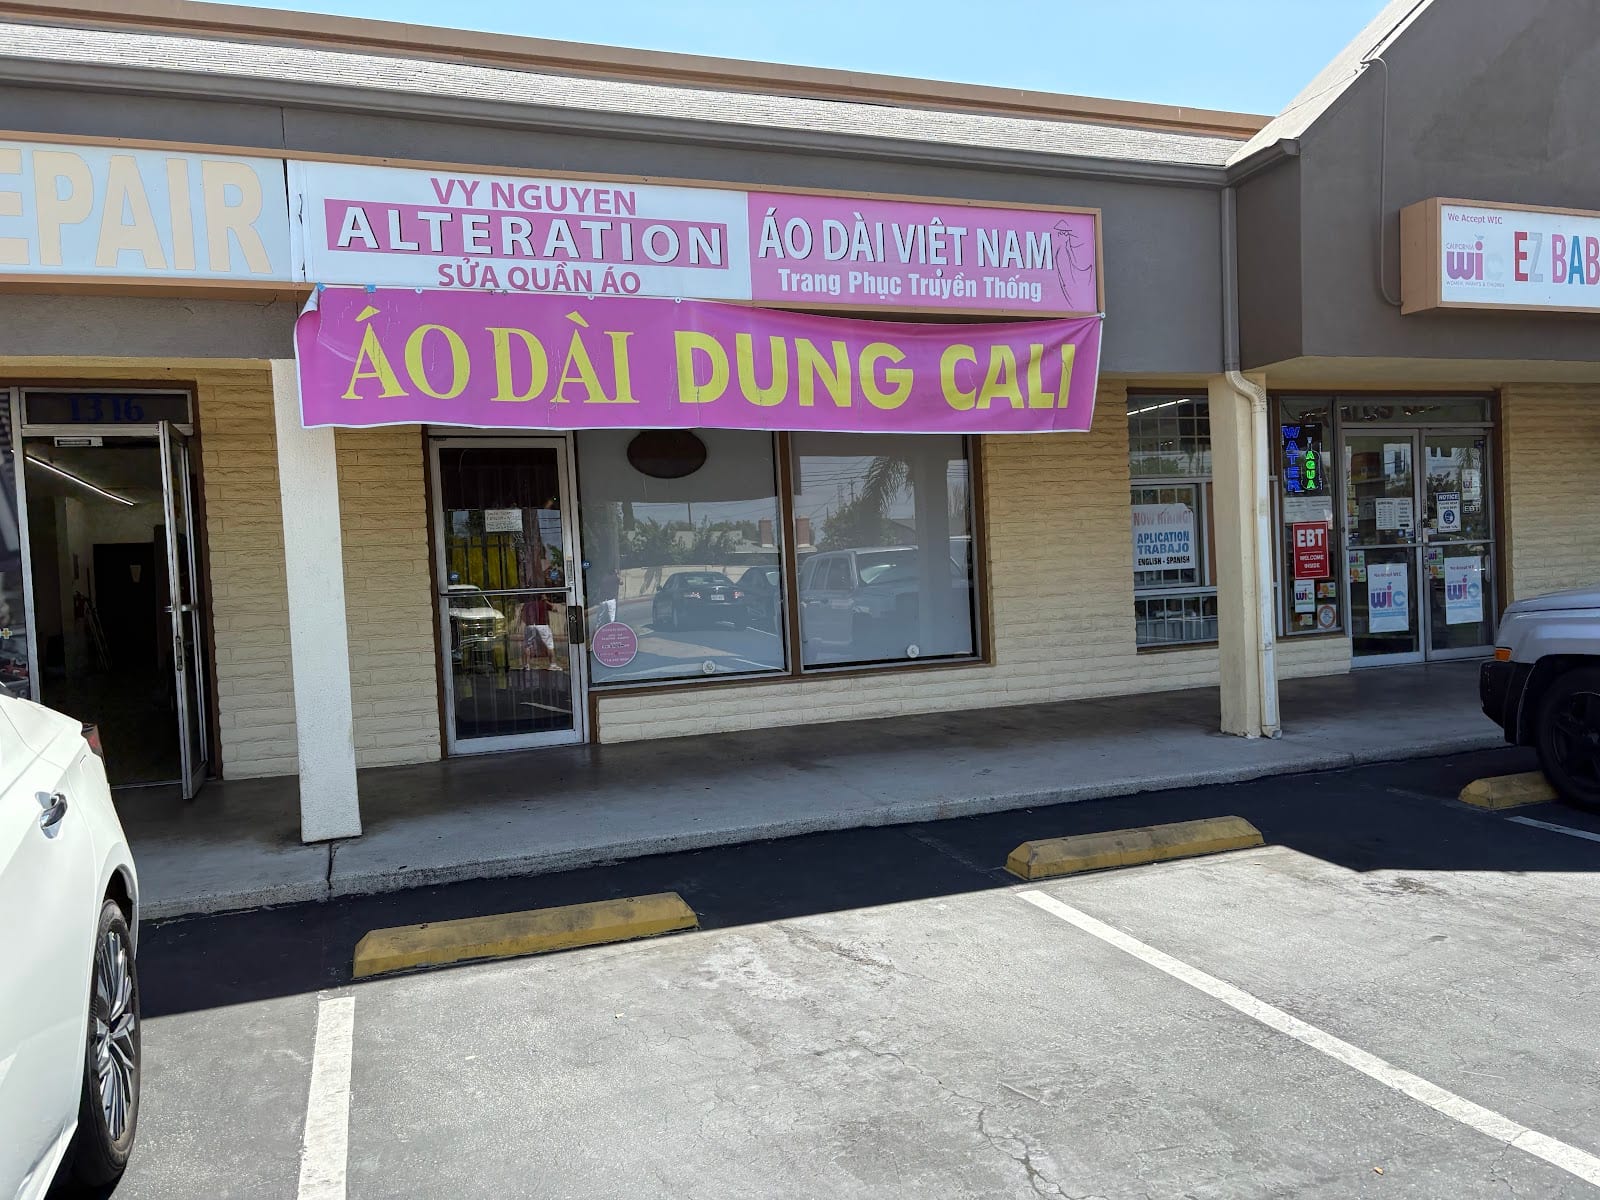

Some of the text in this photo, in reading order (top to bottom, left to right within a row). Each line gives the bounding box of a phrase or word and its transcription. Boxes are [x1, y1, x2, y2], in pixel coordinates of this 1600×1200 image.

[431, 178, 636, 216] VY NGUYEN
[337, 206, 723, 267] ALTERATION
[1447, 213, 1503, 225] We Accept WIC
[758, 207, 813, 261] ÁO
[823, 212, 884, 264] DÀI
[976, 228, 1054, 270] NAM
[438, 257, 641, 294] SỬA QUẦN ÁO
[1514, 231, 1600, 286] EZ BAB
[778, 268, 841, 296] Trang
[848, 270, 902, 301] Phục
[983, 274, 1042, 303] Thống
[340, 305, 1076, 411] ÁO DÀI DUNG CALI
[70, 395, 145, 422] 1316
[1283, 426, 1301, 492] WATER
[1305, 450, 1316, 489] AGUA
[1137, 530, 1190, 545] APLICATION
[1137, 543, 1190, 555] TRABAJO
[1296, 528, 1324, 548] EBT
[1138, 557, 1162, 566] ENGLISH
[1166, 555, 1190, 565] SPANISH
